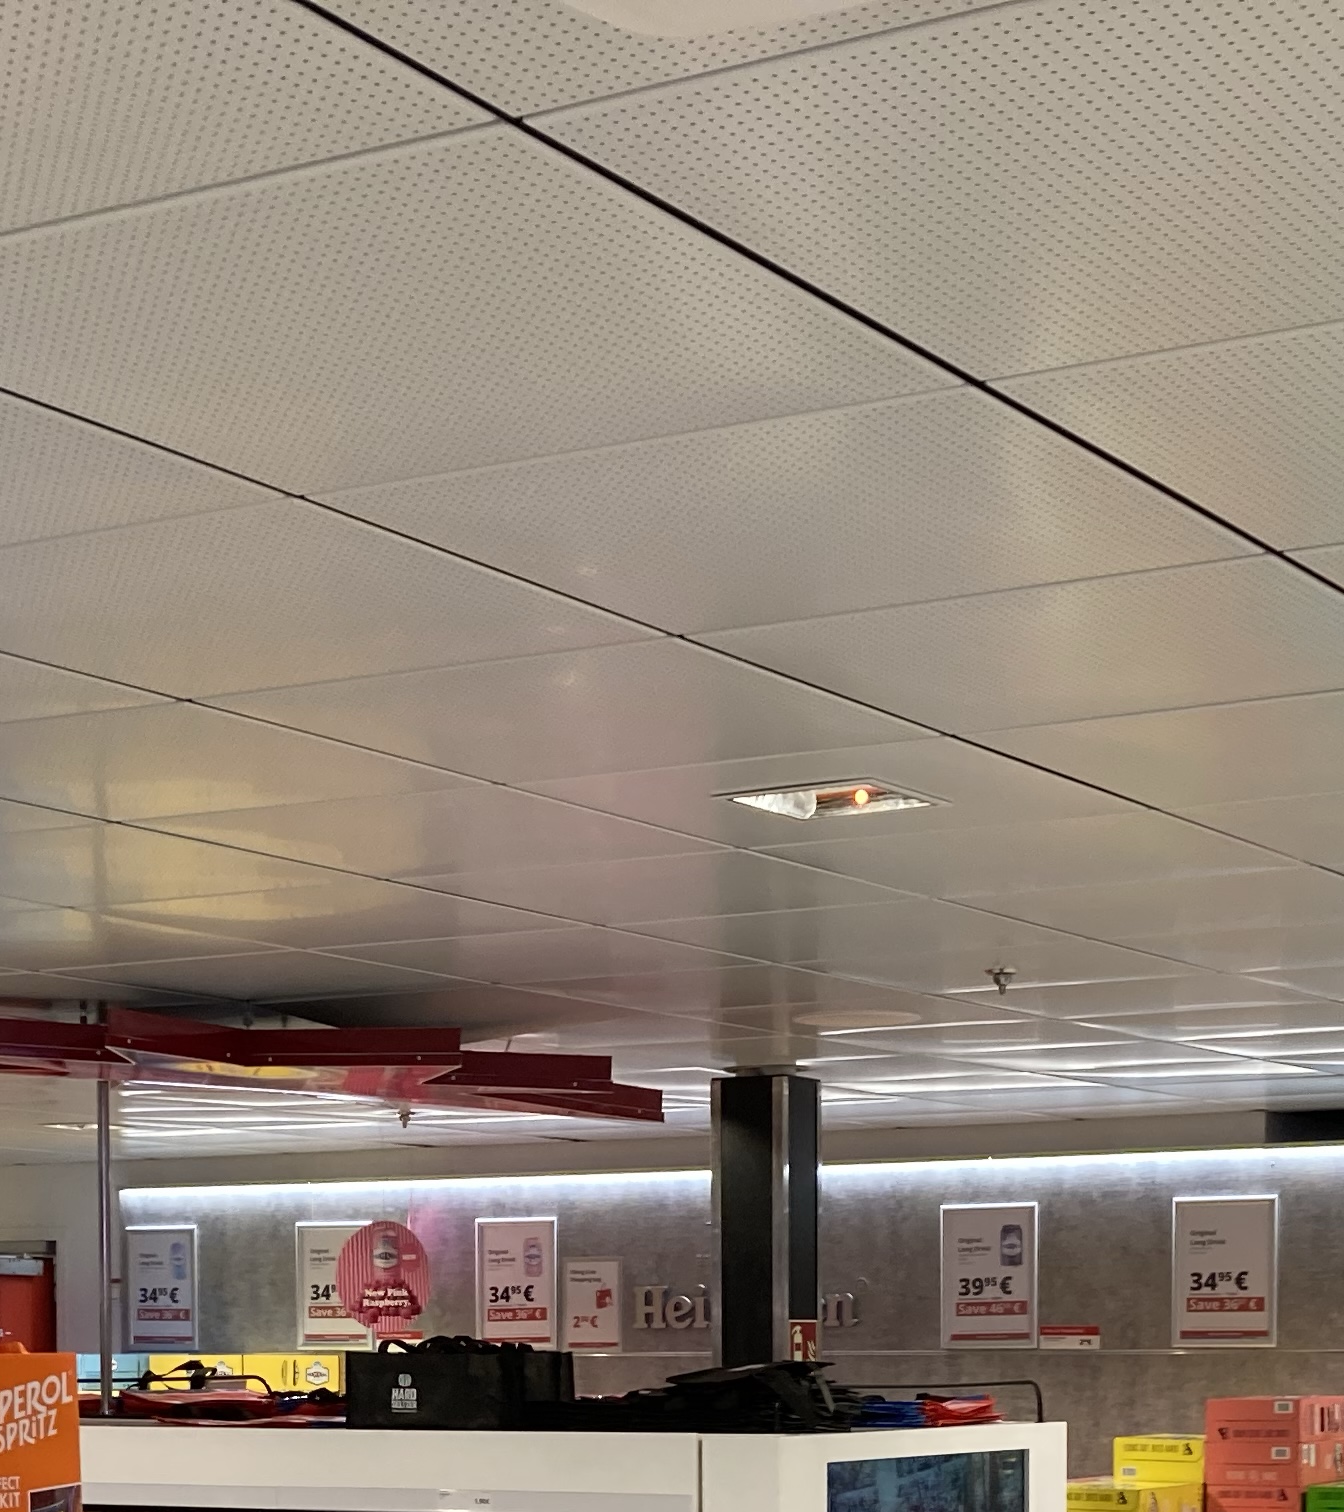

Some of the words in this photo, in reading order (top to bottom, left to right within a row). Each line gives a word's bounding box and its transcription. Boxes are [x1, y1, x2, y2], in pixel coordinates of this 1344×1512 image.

[958, 1304, 987, 1315] Save
[1189, 1299, 1220, 1311] Save
[310, 1307, 334, 1316] Save
[489, 1310, 513, 1319] Save
